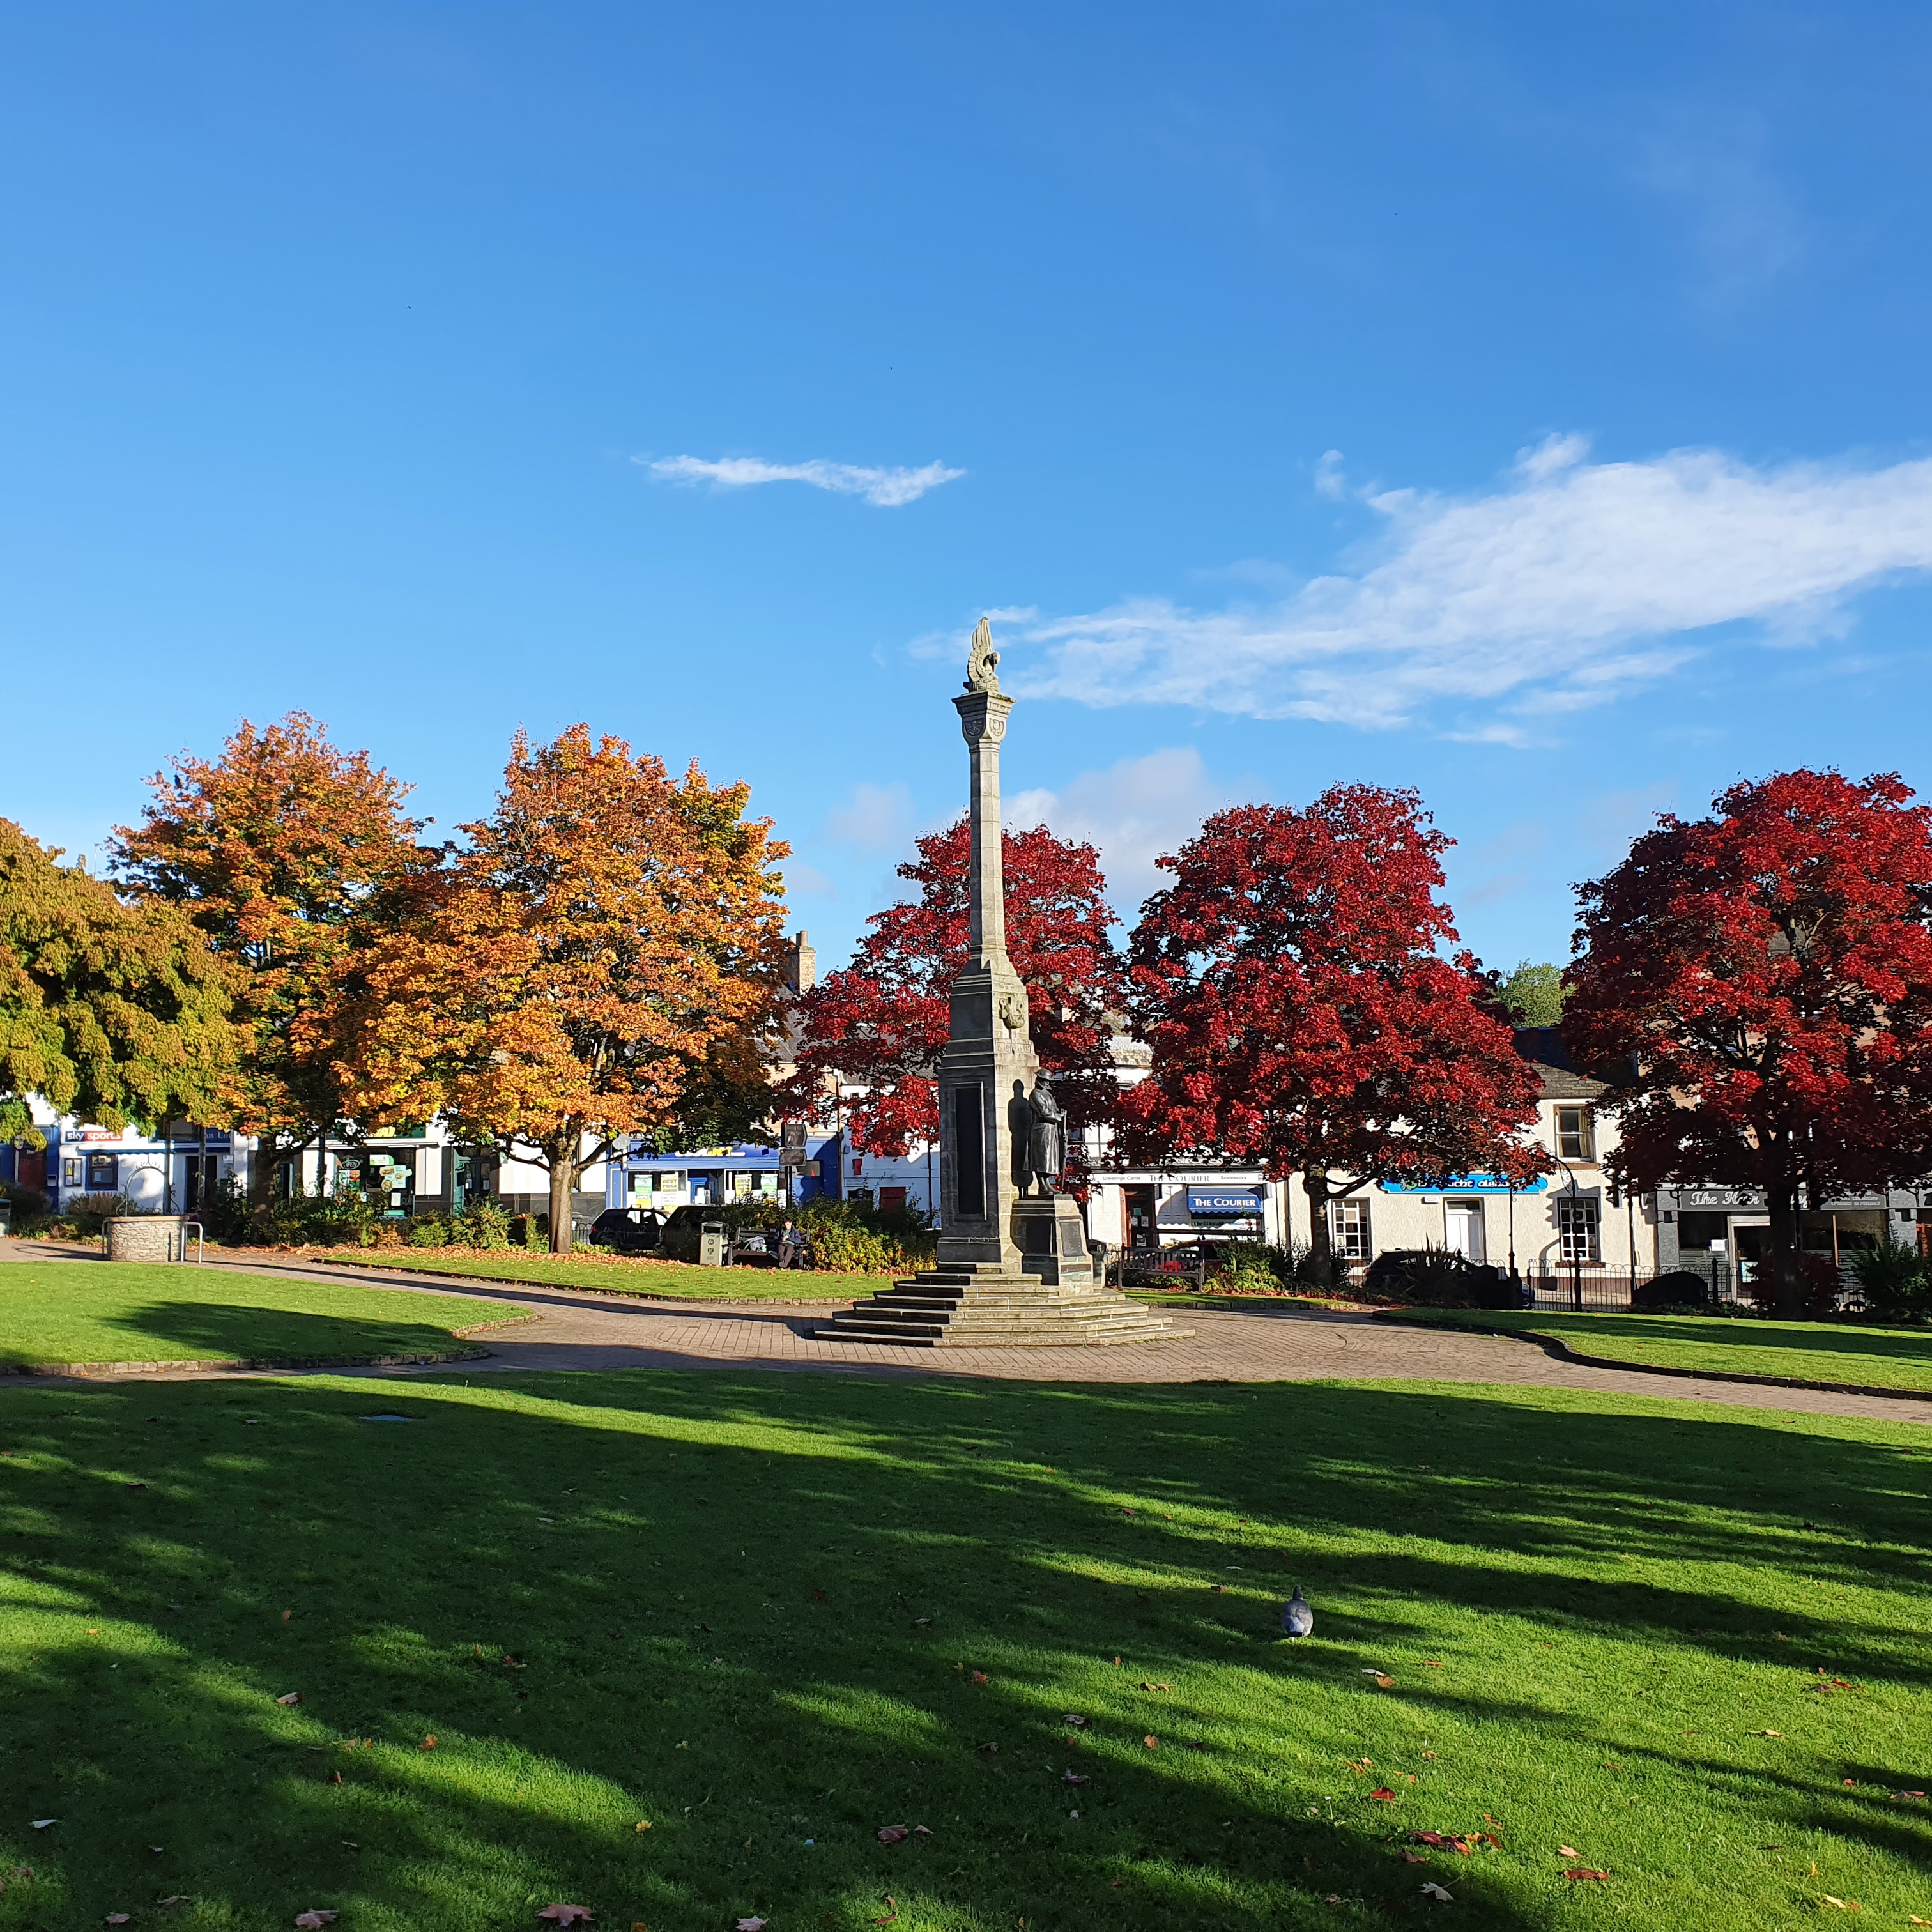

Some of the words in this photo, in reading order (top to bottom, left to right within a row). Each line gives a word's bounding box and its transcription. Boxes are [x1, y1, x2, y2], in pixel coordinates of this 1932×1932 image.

[66, 1131, 84, 1141] sky
[87, 1131, 121, 1141] sports
[1193, 1198, 1211, 1206] THE
[1213, 1198, 1256, 1206] COURIER
[1690, 1192, 1718, 1205] The
